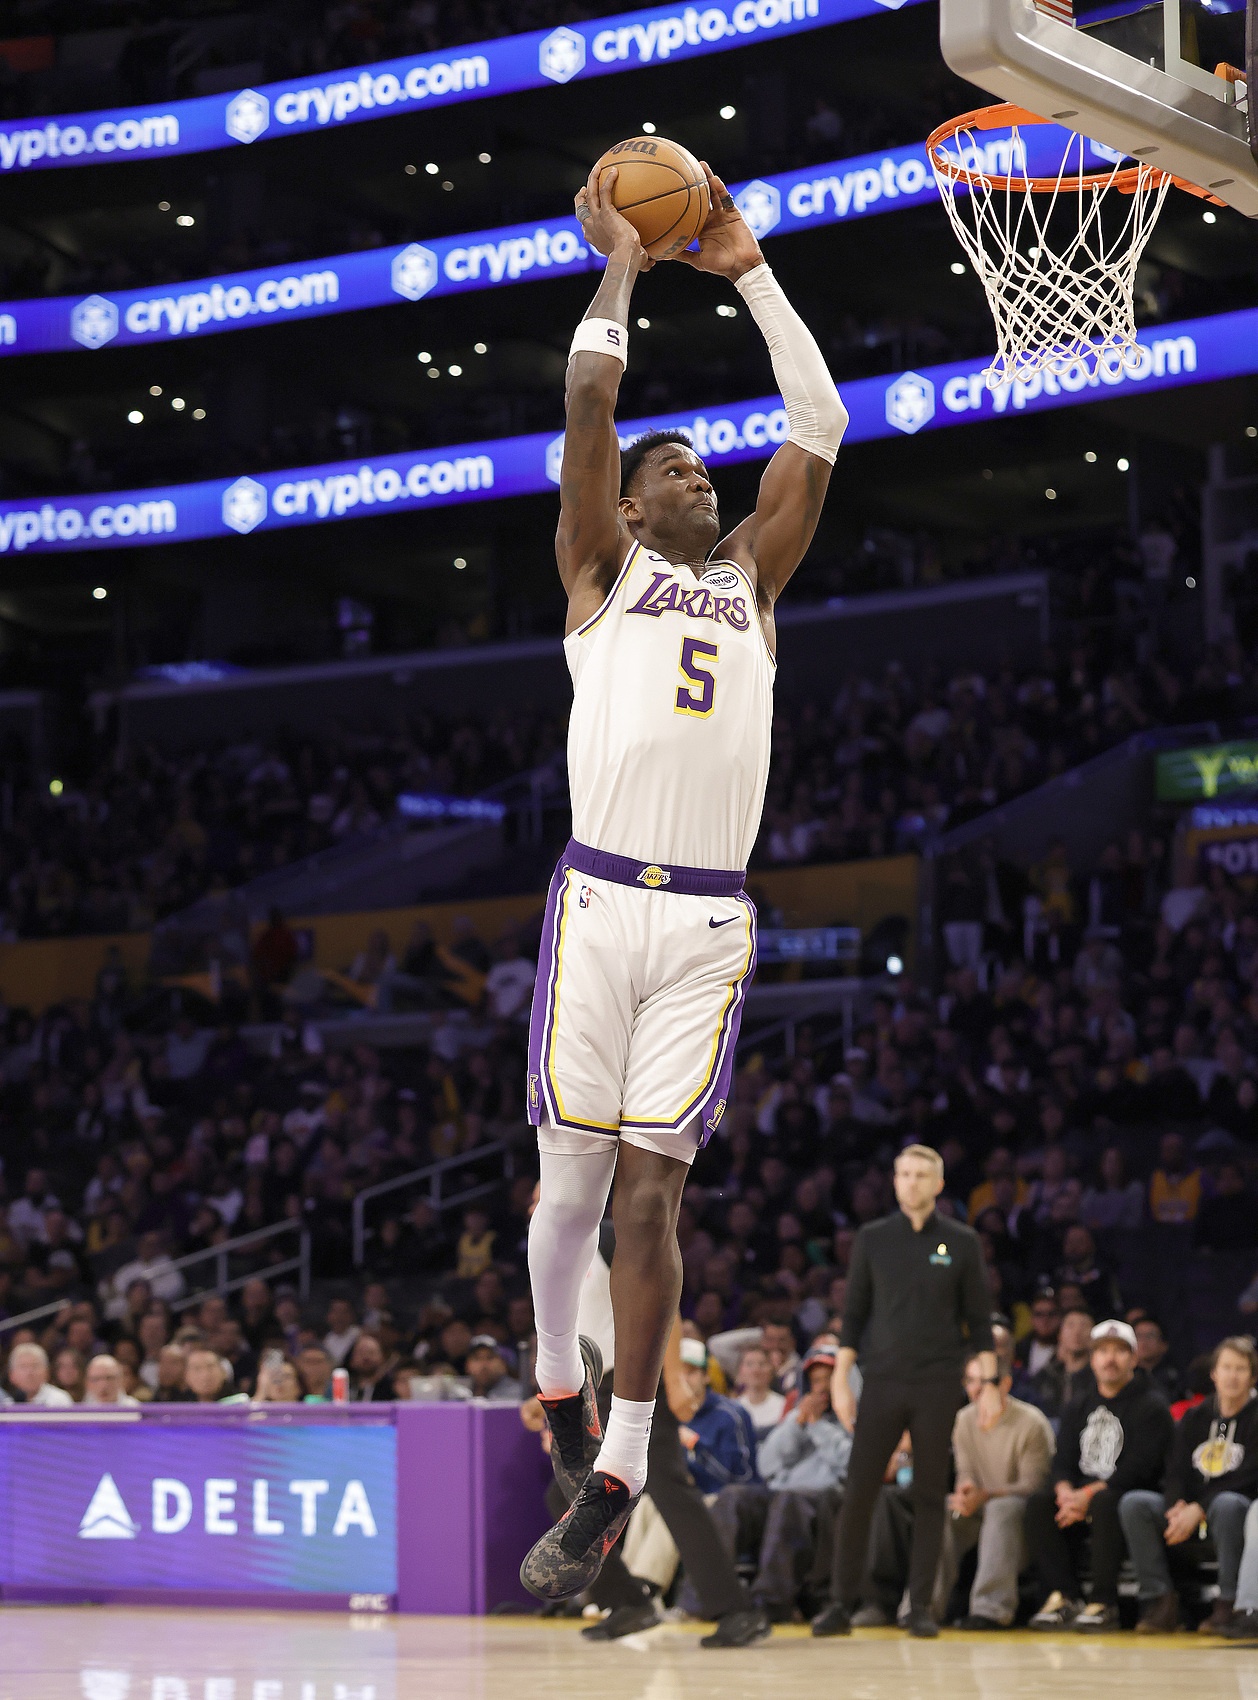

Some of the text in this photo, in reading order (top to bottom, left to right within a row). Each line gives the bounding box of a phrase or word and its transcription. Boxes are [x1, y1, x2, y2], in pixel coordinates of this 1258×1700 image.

[273, 55, 490, 124] crypto.com
[125, 270, 339, 335] crypto.com
[271, 455, 494, 518] crypto.com
[625, 571, 750, 633] LAKERS
[674, 635, 719, 720] 5
[636, 869, 671, 884] LAKERS
[152, 1478, 378, 1537] DELTA
